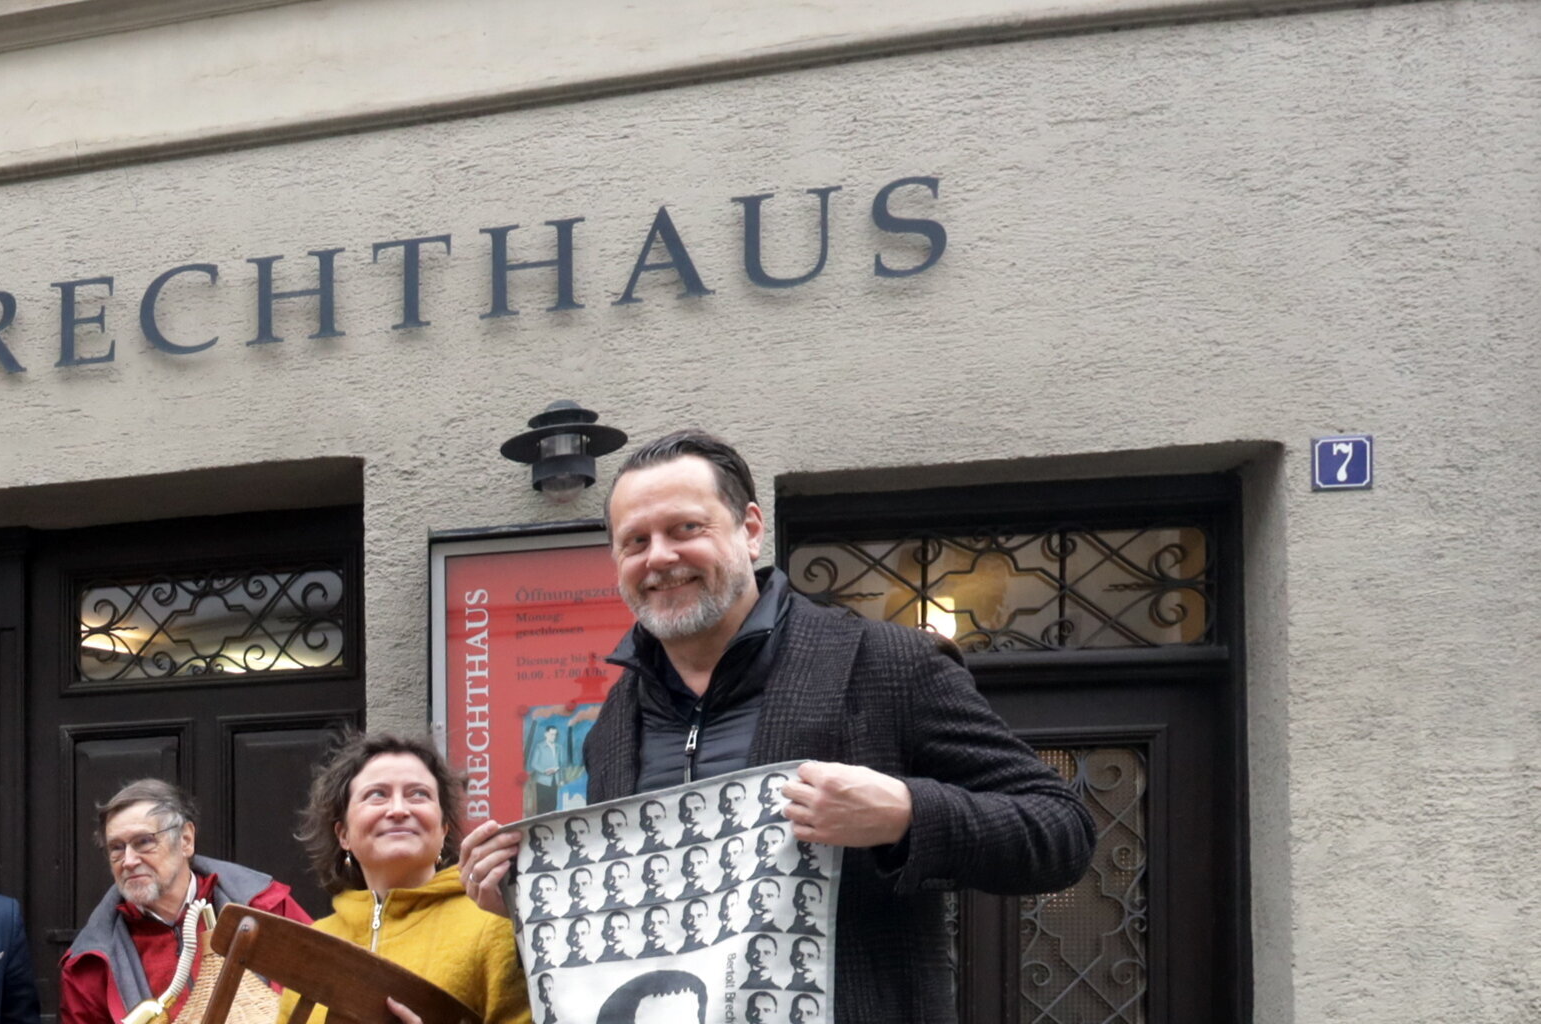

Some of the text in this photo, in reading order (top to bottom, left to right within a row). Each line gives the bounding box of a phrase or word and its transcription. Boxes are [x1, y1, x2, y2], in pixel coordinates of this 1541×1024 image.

[1332, 442, 1353, 482] 7
[464, 588, 491, 821] BRECHTHAUS
[724, 953, 737, 990] Bertolt
